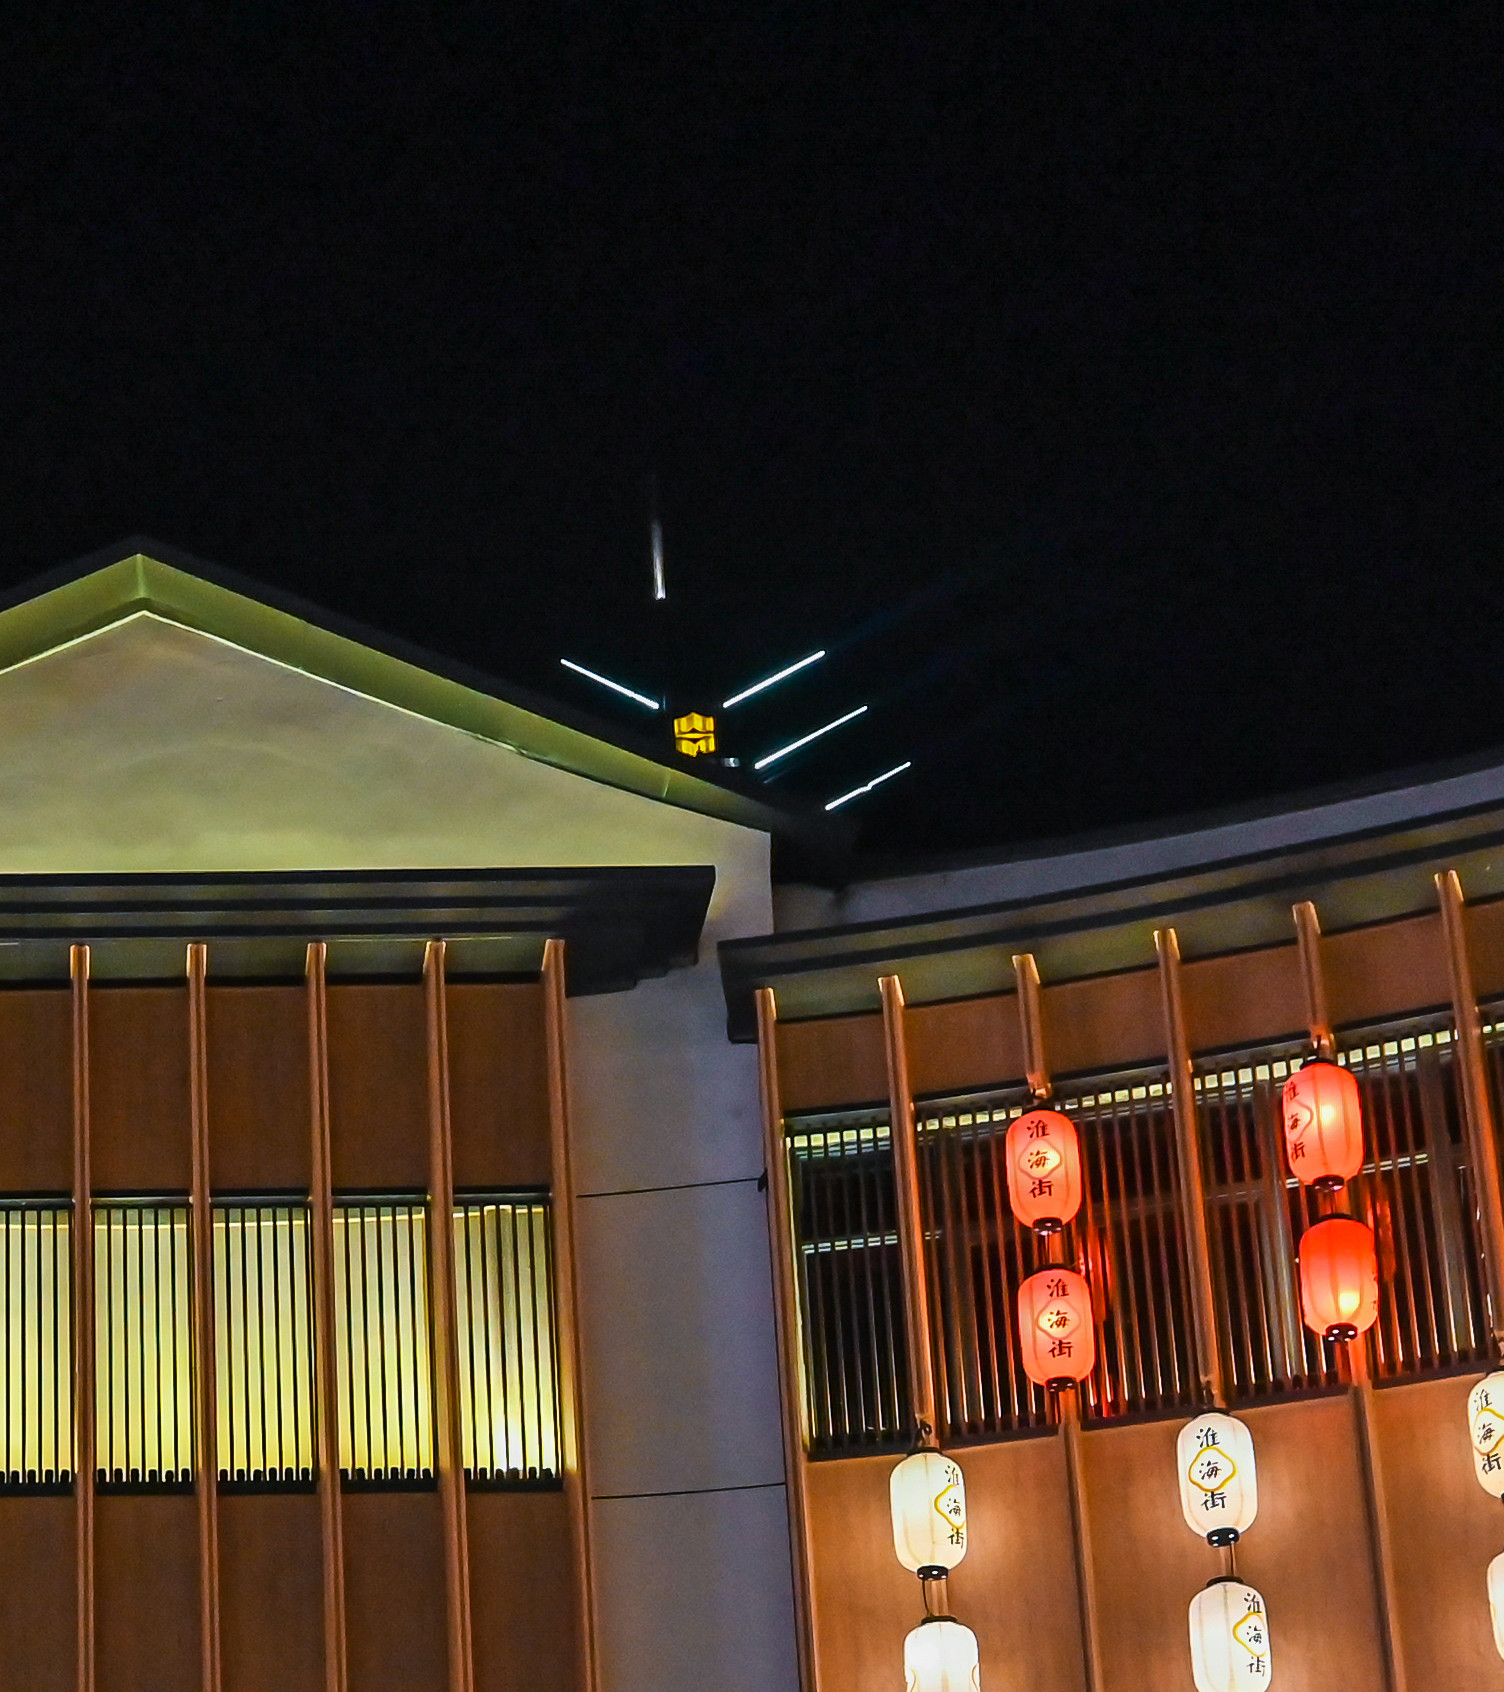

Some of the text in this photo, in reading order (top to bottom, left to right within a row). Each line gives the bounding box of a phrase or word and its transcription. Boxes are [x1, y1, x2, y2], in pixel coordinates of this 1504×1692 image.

[1028, 1119, 1054, 1199] 淮海街
[1046, 1277, 1073, 1358] 淮海街
[1196, 1427, 1228, 1510] 淮海街
[1473, 1389, 1504, 1474] 淮海街
